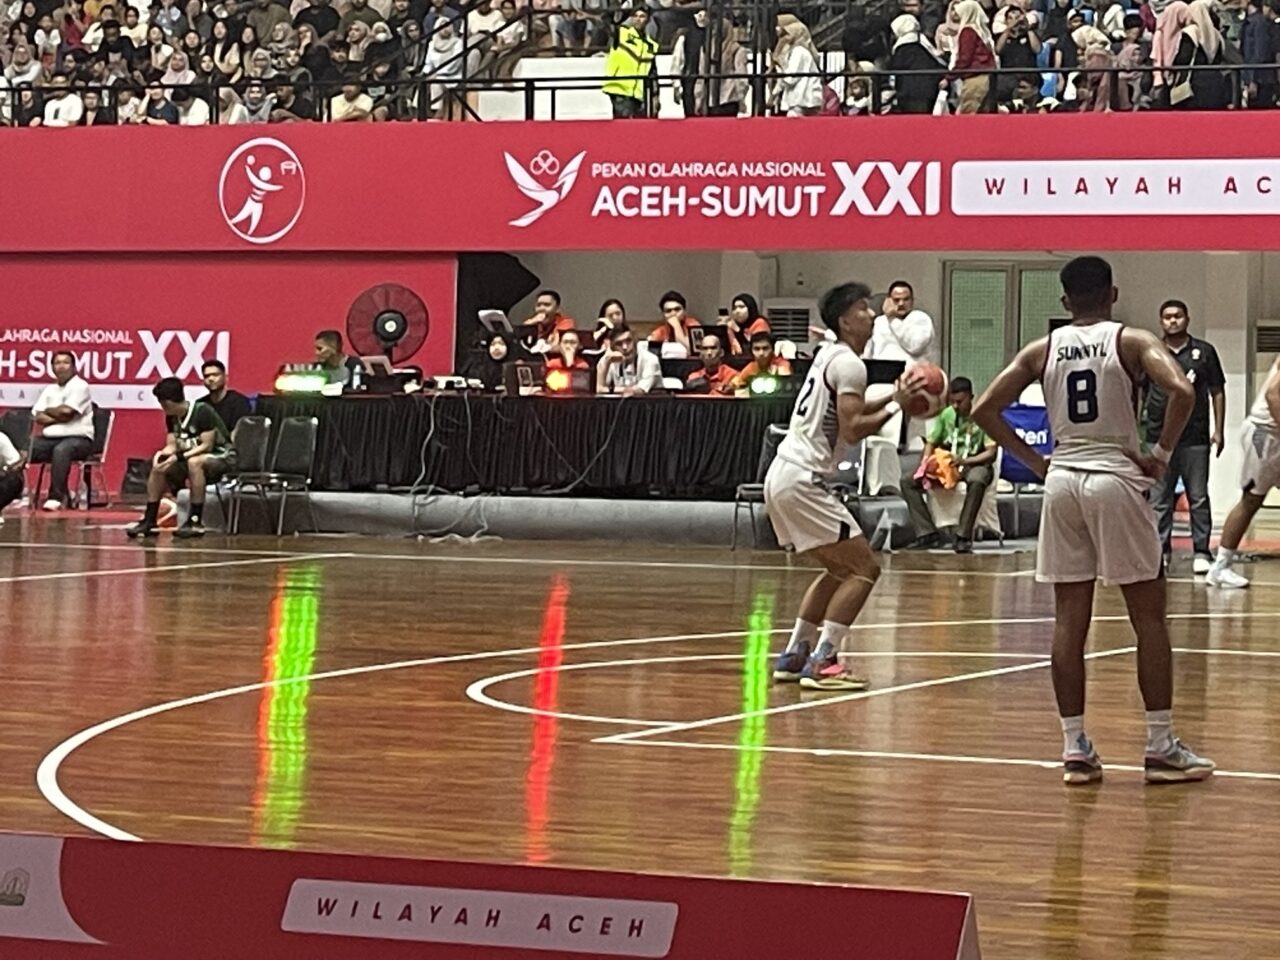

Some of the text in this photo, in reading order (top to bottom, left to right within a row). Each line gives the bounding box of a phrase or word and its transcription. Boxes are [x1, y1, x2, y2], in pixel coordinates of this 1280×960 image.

[591, 161, 941, 217] ACEH-SUMUT XXI
[592, 161, 826, 178] PEKAN OLAHRAGA NASIONAL
[984, 176, 1181, 196] WILAYAH
[62, 328, 133, 344] NASIONAL
[135, 330, 230, 380] XXI
[1066, 368, 1099, 425] 8
[316, 897, 644, 938] WILAYAH ACEH
